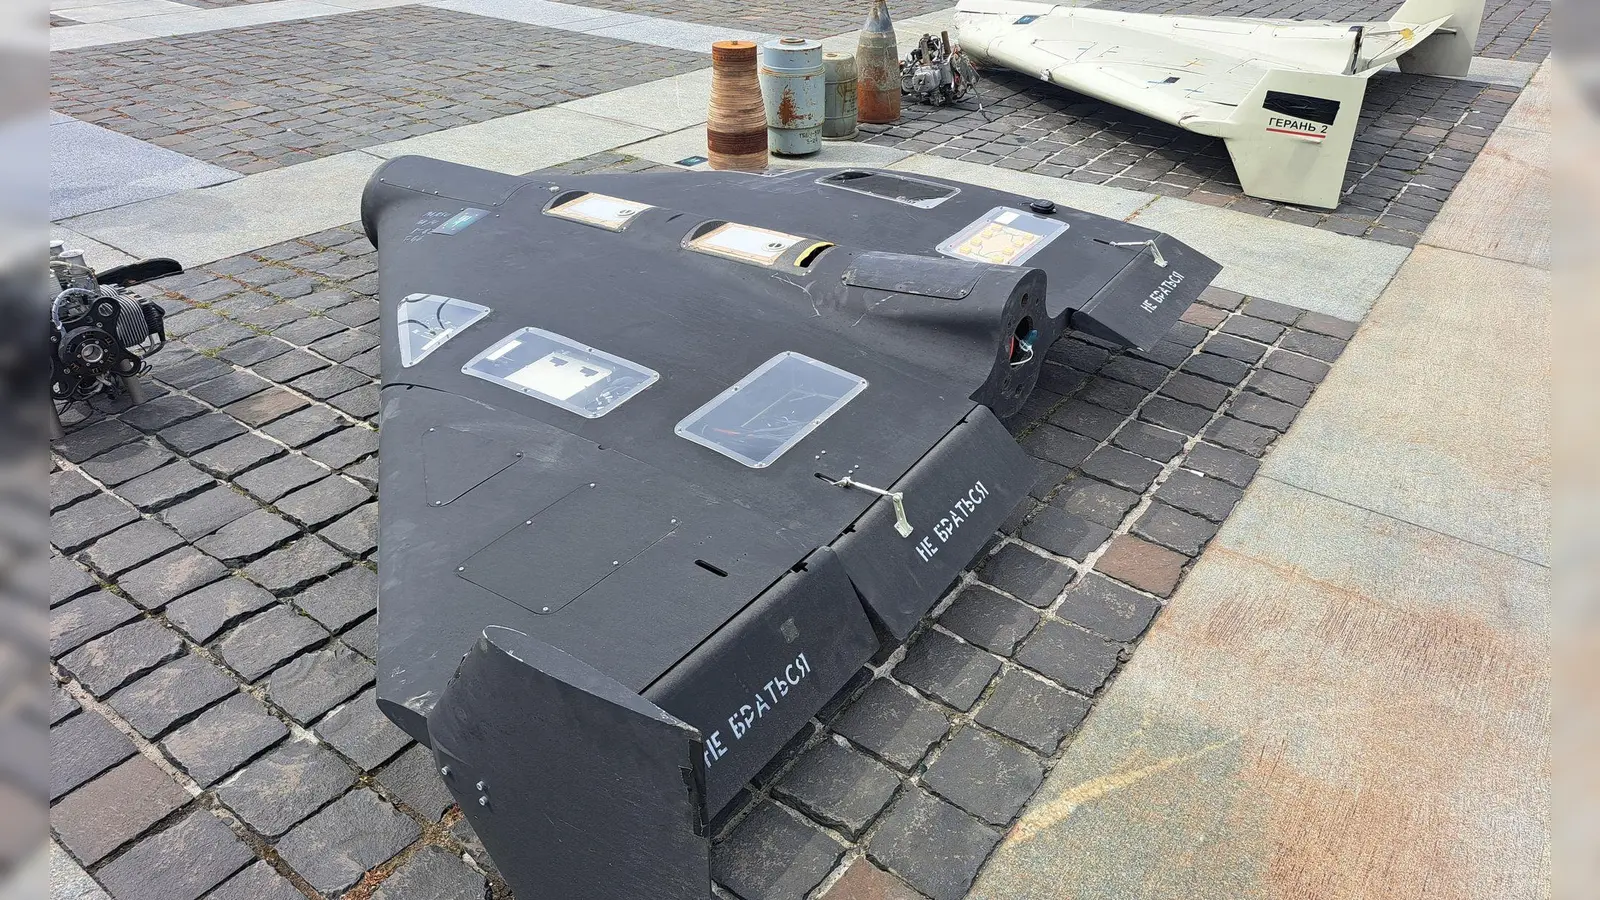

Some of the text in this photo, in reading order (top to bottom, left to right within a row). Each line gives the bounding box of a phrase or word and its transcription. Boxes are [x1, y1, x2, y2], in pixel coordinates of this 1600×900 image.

[1268, 117, 1328, 134] ГЕРАНЬ 2
[1140, 270, 1185, 313] НЕ БРАТЬСЯ
[915, 480, 990, 563] НЕ БРАТЬСЯ
[703, 652, 811, 768] НЕ БРАТЬСЯ
